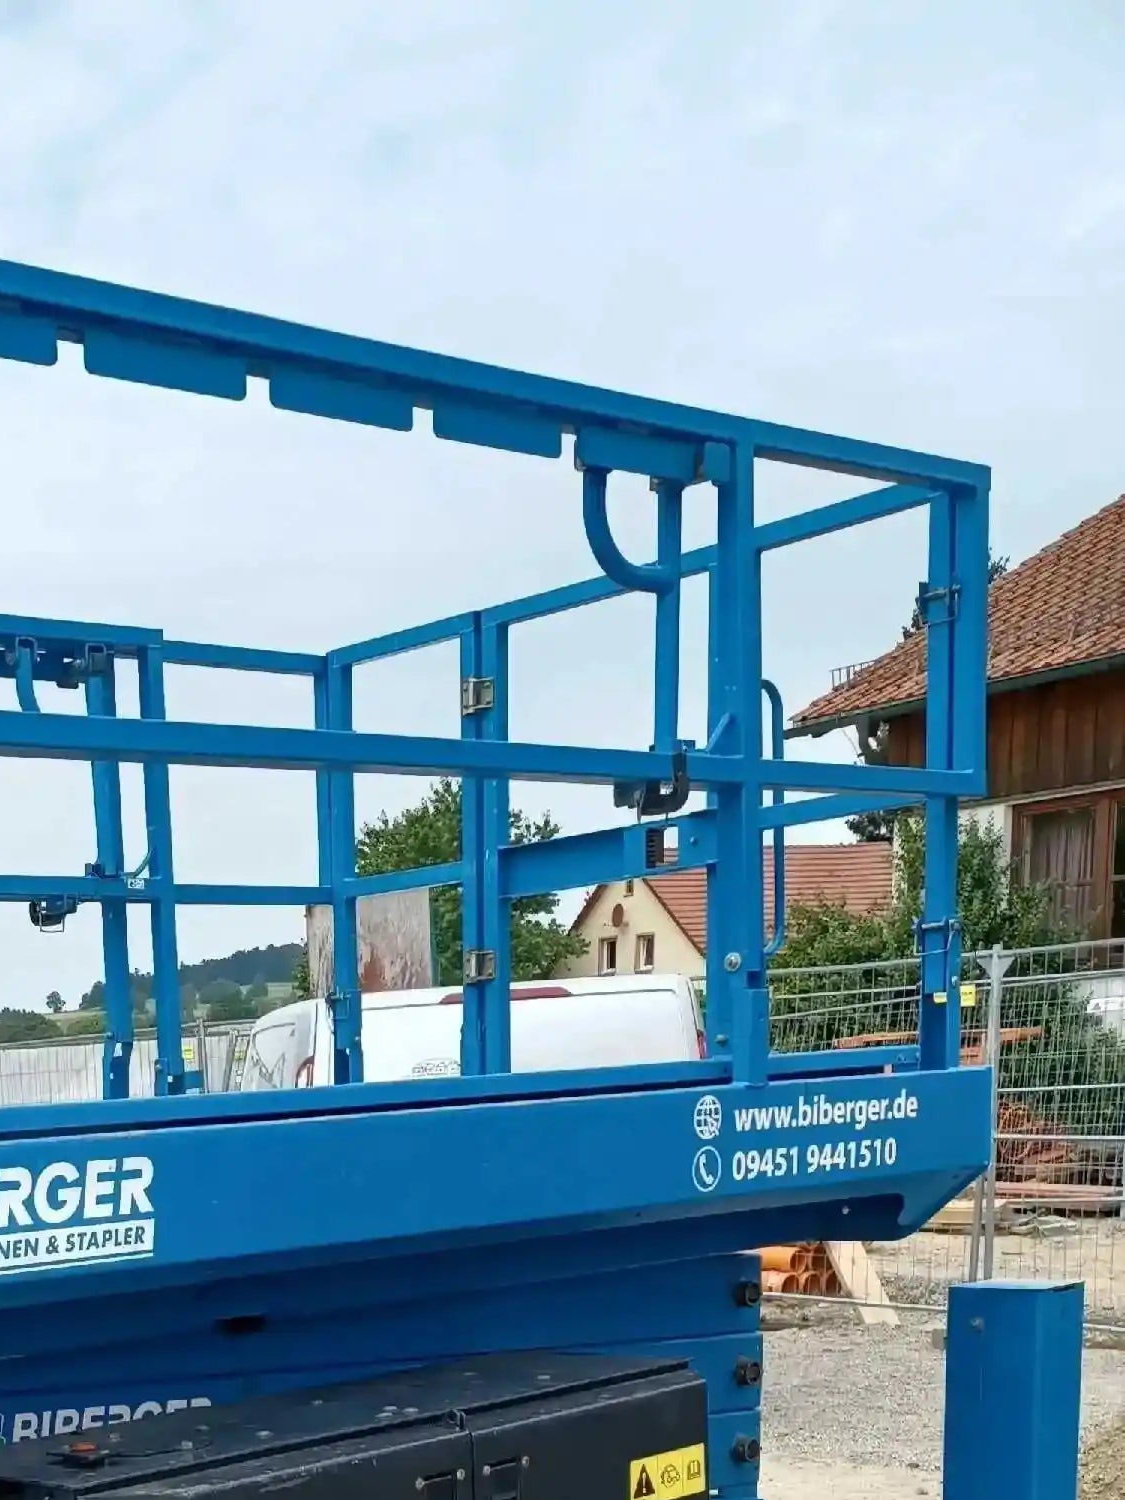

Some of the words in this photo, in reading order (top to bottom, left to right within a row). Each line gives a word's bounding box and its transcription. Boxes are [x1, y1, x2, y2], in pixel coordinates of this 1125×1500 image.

[734, 1089, 918, 1132] www.biberger.de
[732, 1146, 799, 1182] 09451
[806, 1137, 897, 1173] 9441510
[46, 1234, 60, 1254] &
[64, 1225, 146, 1252] STAPLER
